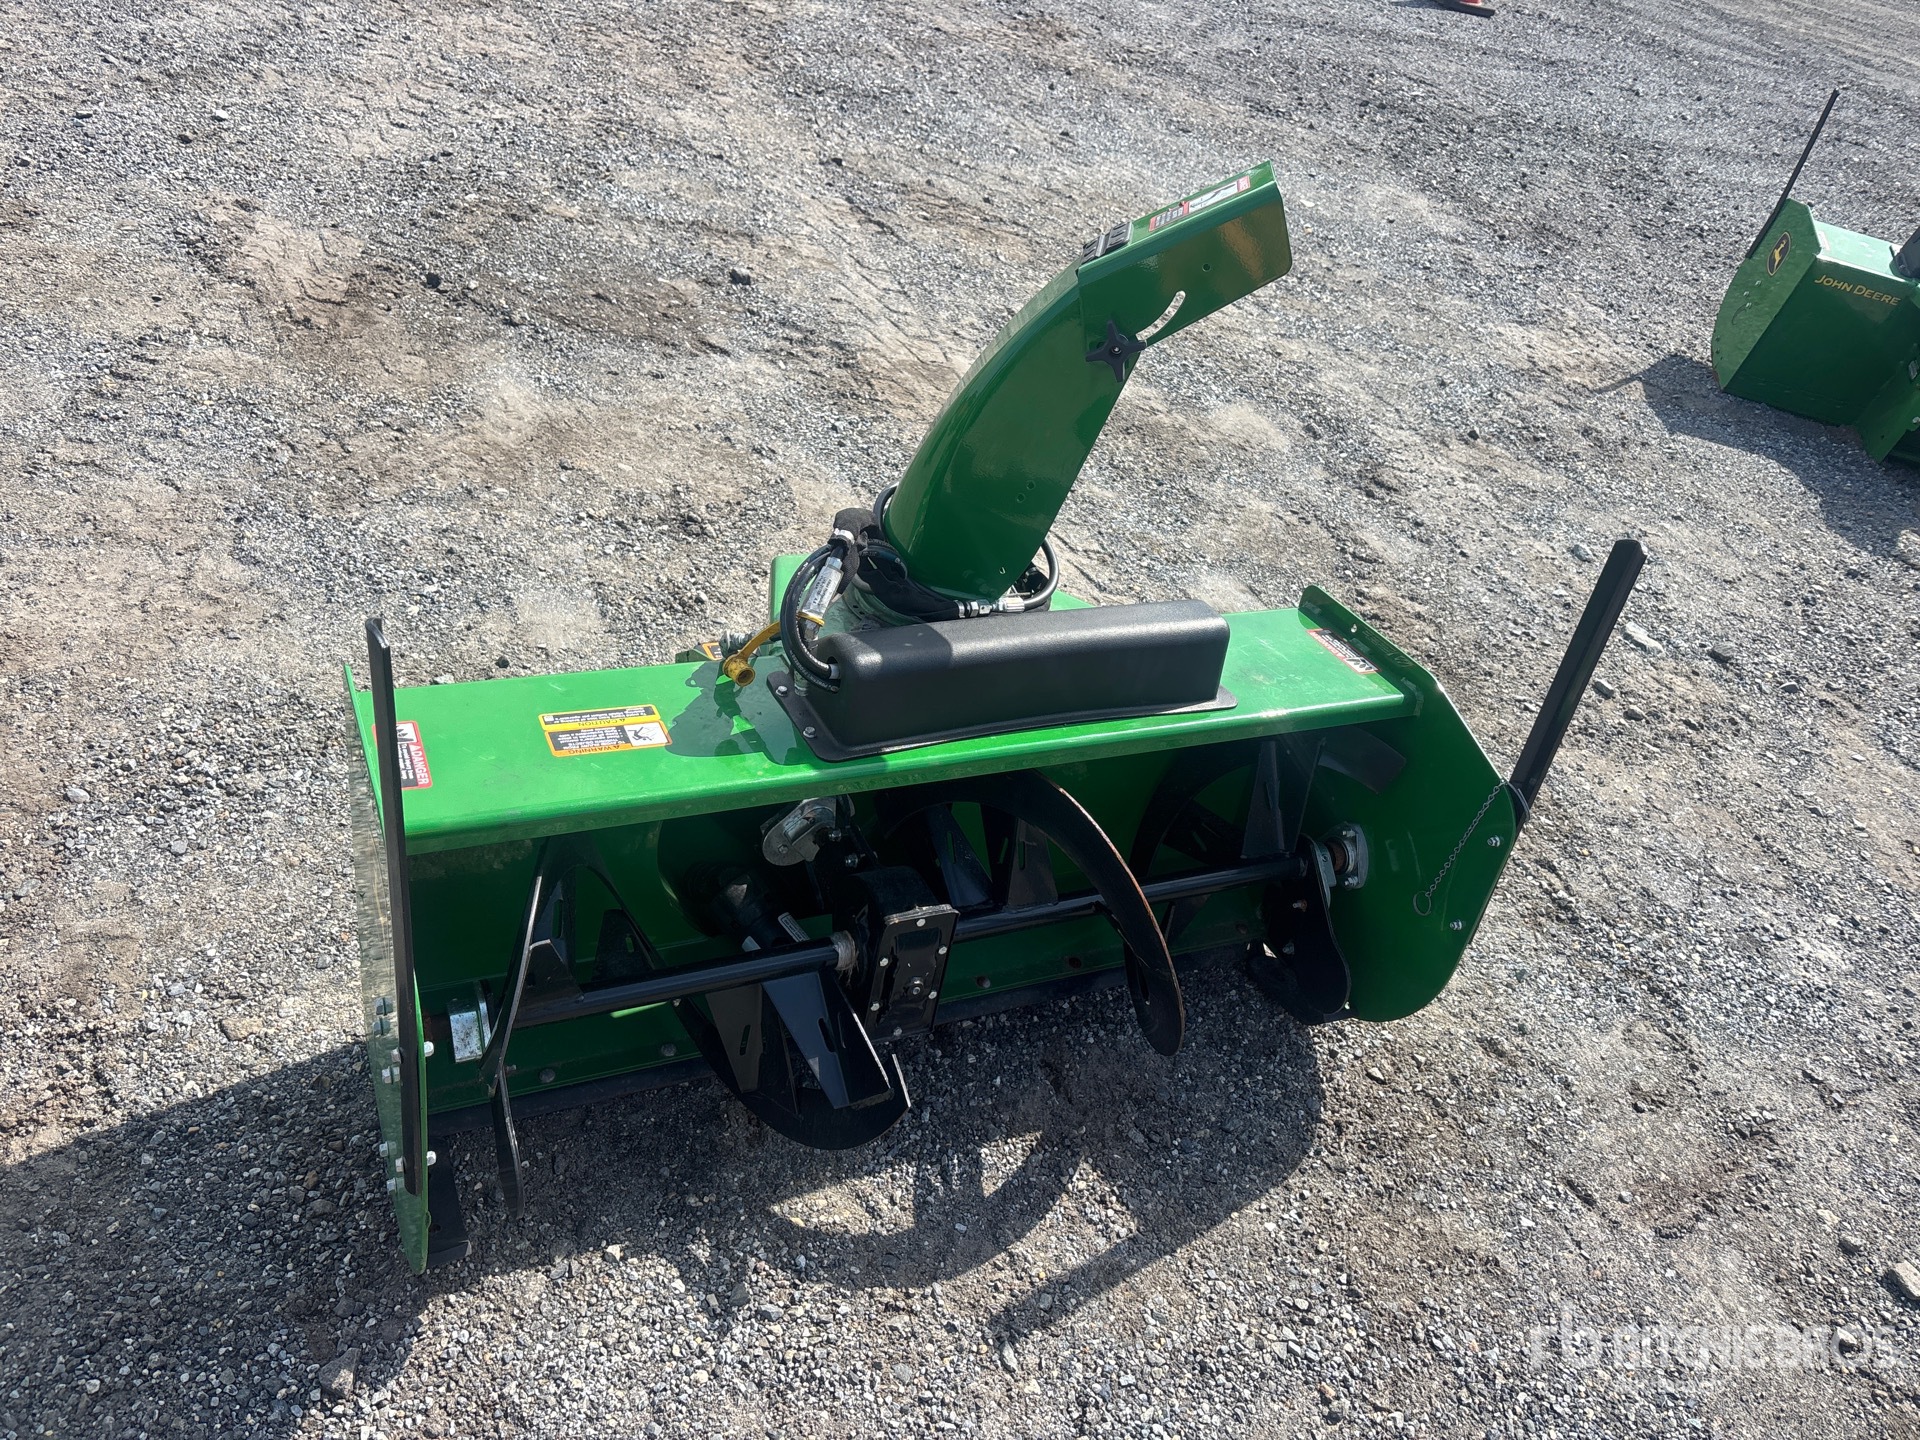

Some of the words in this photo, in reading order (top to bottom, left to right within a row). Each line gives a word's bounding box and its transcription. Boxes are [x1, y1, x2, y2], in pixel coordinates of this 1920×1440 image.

[1814, 274, 1854, 292] JOHN
[1853, 284, 1901, 306] DEERE
[568, 745, 614, 755] WARNING
[411, 750, 430, 785] DANGER
